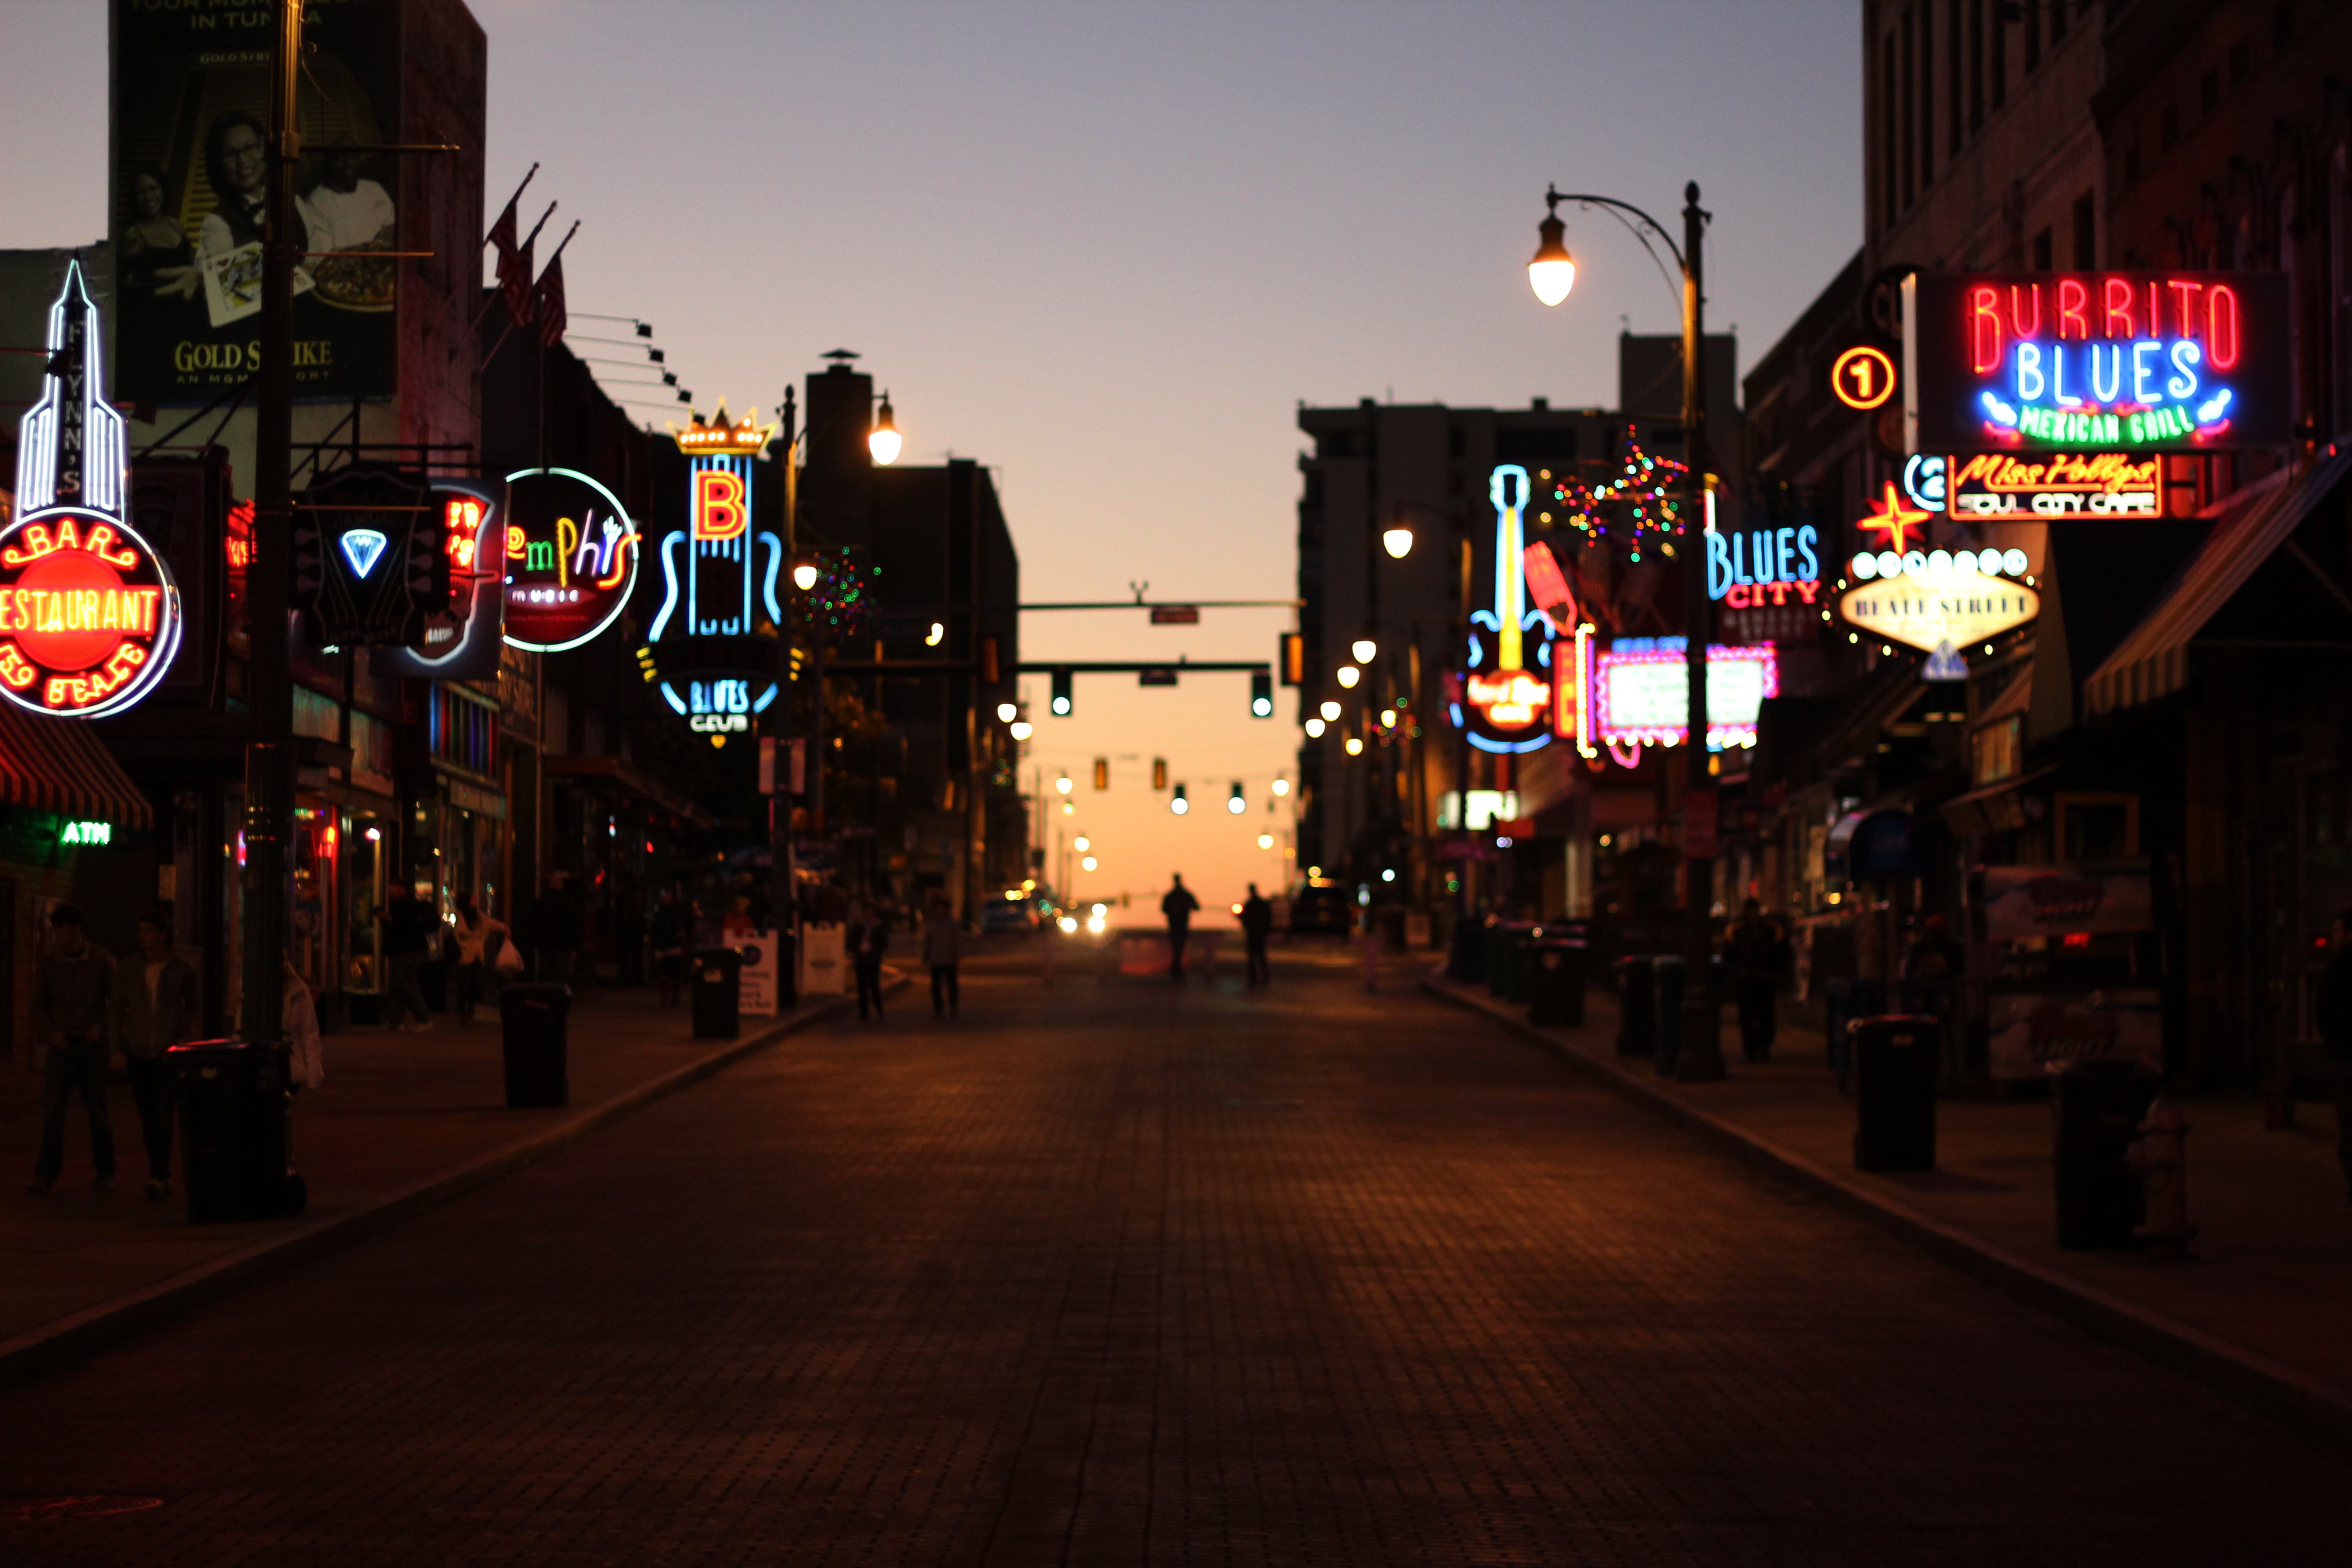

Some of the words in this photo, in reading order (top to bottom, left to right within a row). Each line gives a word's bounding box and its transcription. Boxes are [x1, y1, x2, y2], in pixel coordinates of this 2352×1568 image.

[191, 13, 216, 29] IN
[223, 9, 322, 28] TUNA
[239, 50, 270, 63] STRI
[1971, 279, 2238, 374] BURRITO
[174, 340, 243, 372] GOLD
[246, 339, 332, 371] SIKE
[2014, 339, 2201, 406] BLUES
[176, 374, 199, 384] AN
[295, 370, 331, 382] ORT
[1848, 358, 1872, 397] 1
[62, 319, 83, 494] FYNN'S
[2019, 405, 2121, 444] MEXICAN
[2129, 405, 2195, 444] GRILL
[1955, 454, 2045, 486] Miss
[694, 469, 748, 541] B
[1957, 493, 2028, 515] SOUL
[2031, 493, 2085, 515] CITY
[2088, 493, 2156, 515] CAFE
[24, 519, 116, 557] BAR
[505, 507, 643, 589] emphis
[1706, 524, 1818, 600] BLUES
[0, 589, 159, 632] ESTAURANT
[1725, 580, 1821, 609] CITY
[1940, 595, 2031, 615] STREET
[48, 642, 144, 703] BEALE
[690, 679, 749, 713] BLUES
[690, 714, 749, 733] CLUB
[62, 821, 110, 845] ATM
